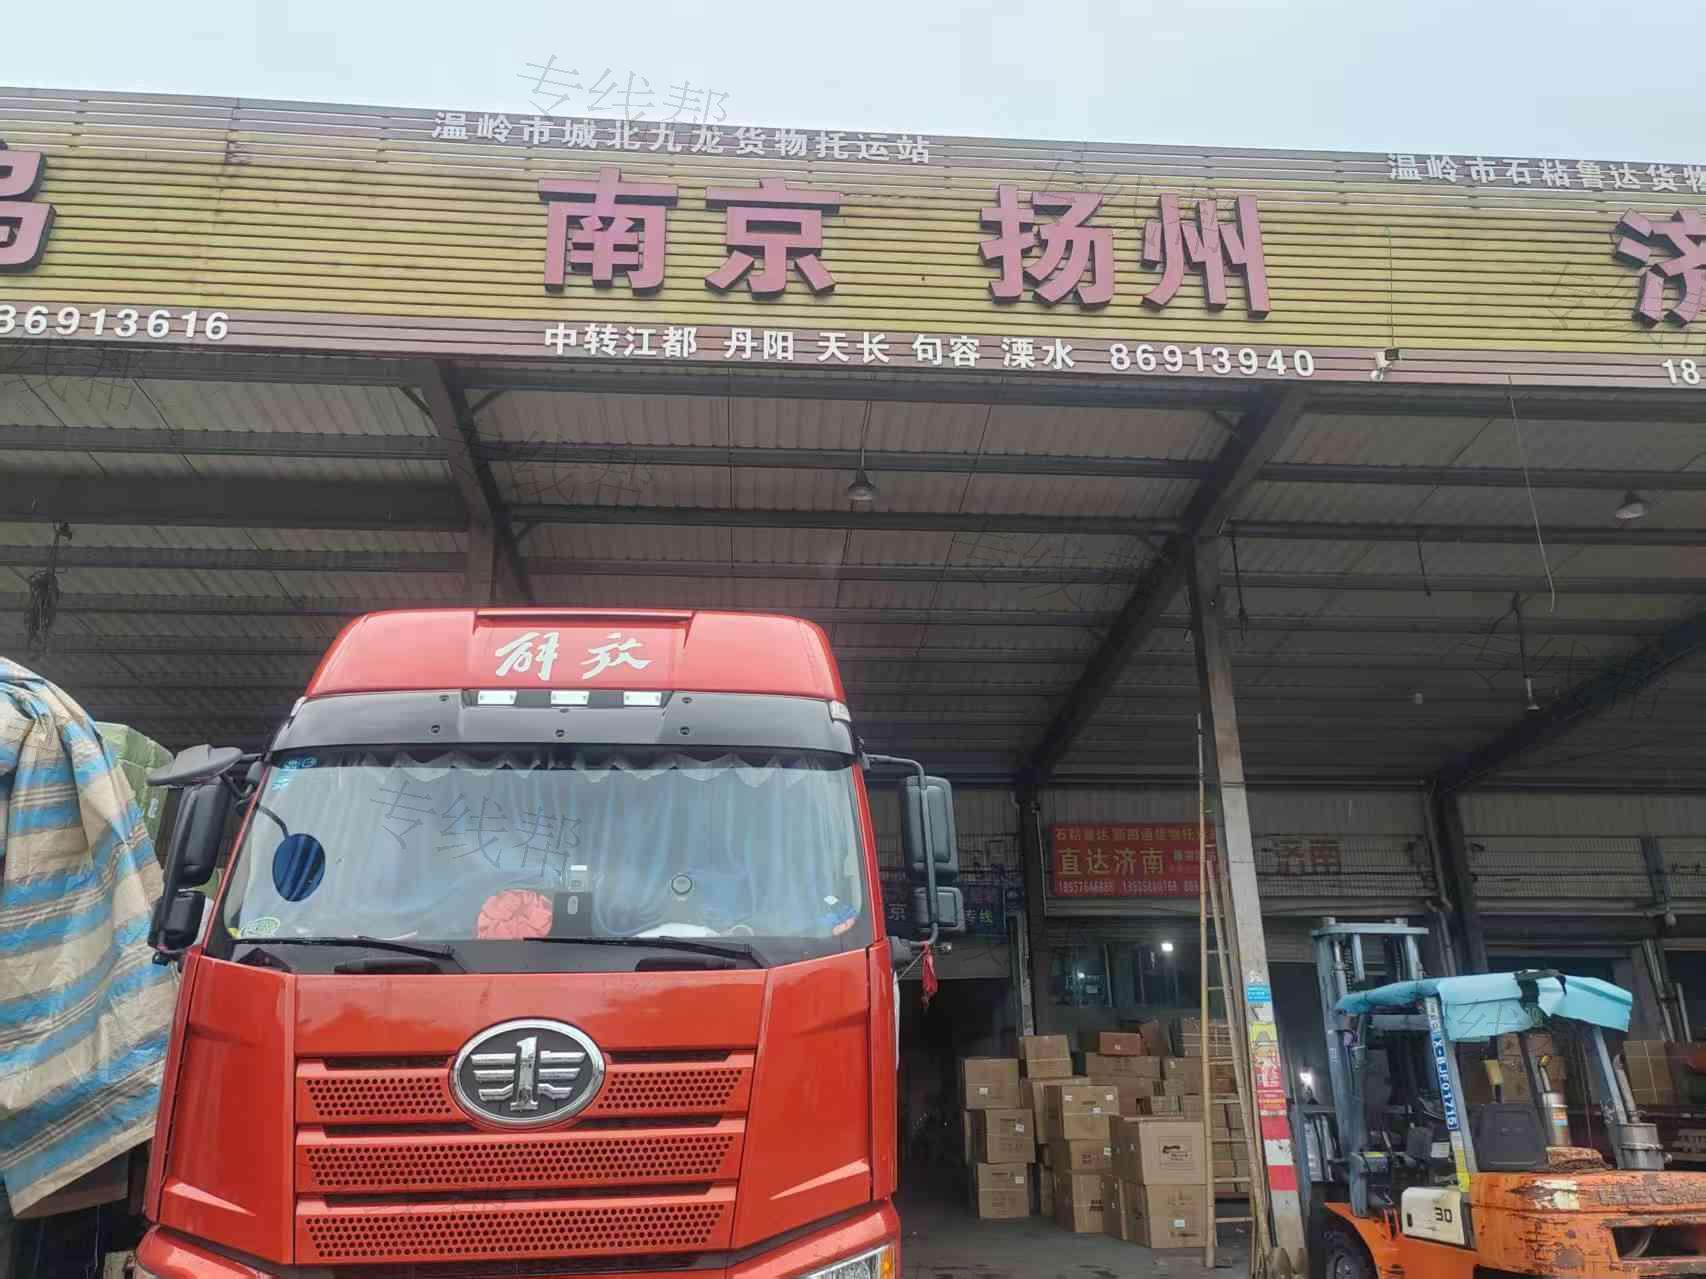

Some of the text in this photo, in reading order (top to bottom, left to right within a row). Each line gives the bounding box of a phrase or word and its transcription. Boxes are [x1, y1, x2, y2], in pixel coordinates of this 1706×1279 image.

[432, 111, 930, 164] 温岭市城北九龙货物托运站
[538, 167, 1271, 319] 南京 扬州
[544, 322, 1315, 377] 中转江都 丹阳 天长 句容 溧水 86913940
[1661, 358, 1700, 386] 18
[1058, 847, 1165, 876] 直达济南
